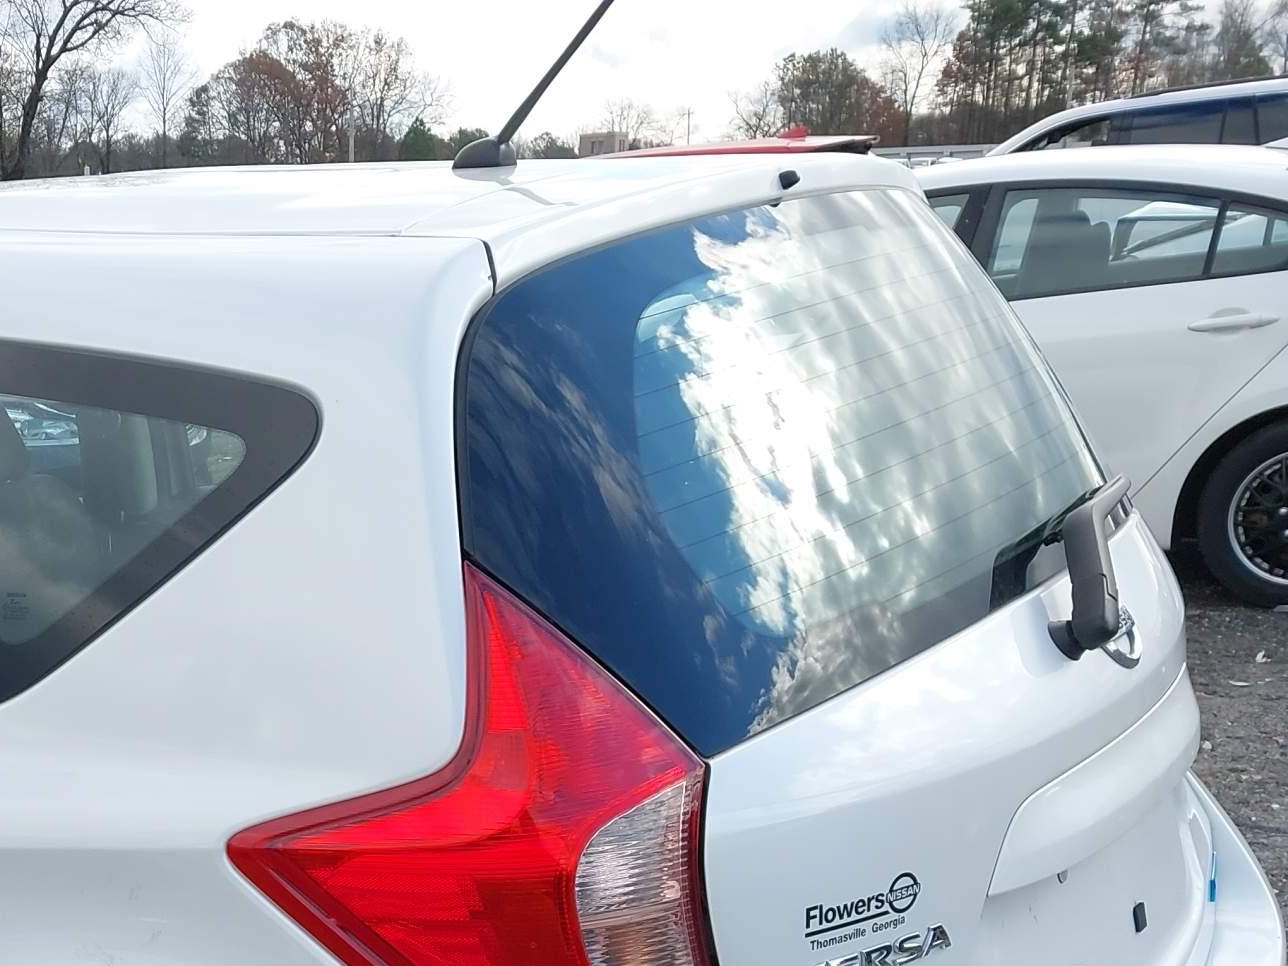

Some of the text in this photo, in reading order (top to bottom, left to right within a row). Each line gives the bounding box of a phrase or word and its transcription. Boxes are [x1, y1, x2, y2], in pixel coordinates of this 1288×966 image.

[805, 882, 921, 930] Flowers NISSAN
[810, 914, 906, 951] Thomasville Georgia
